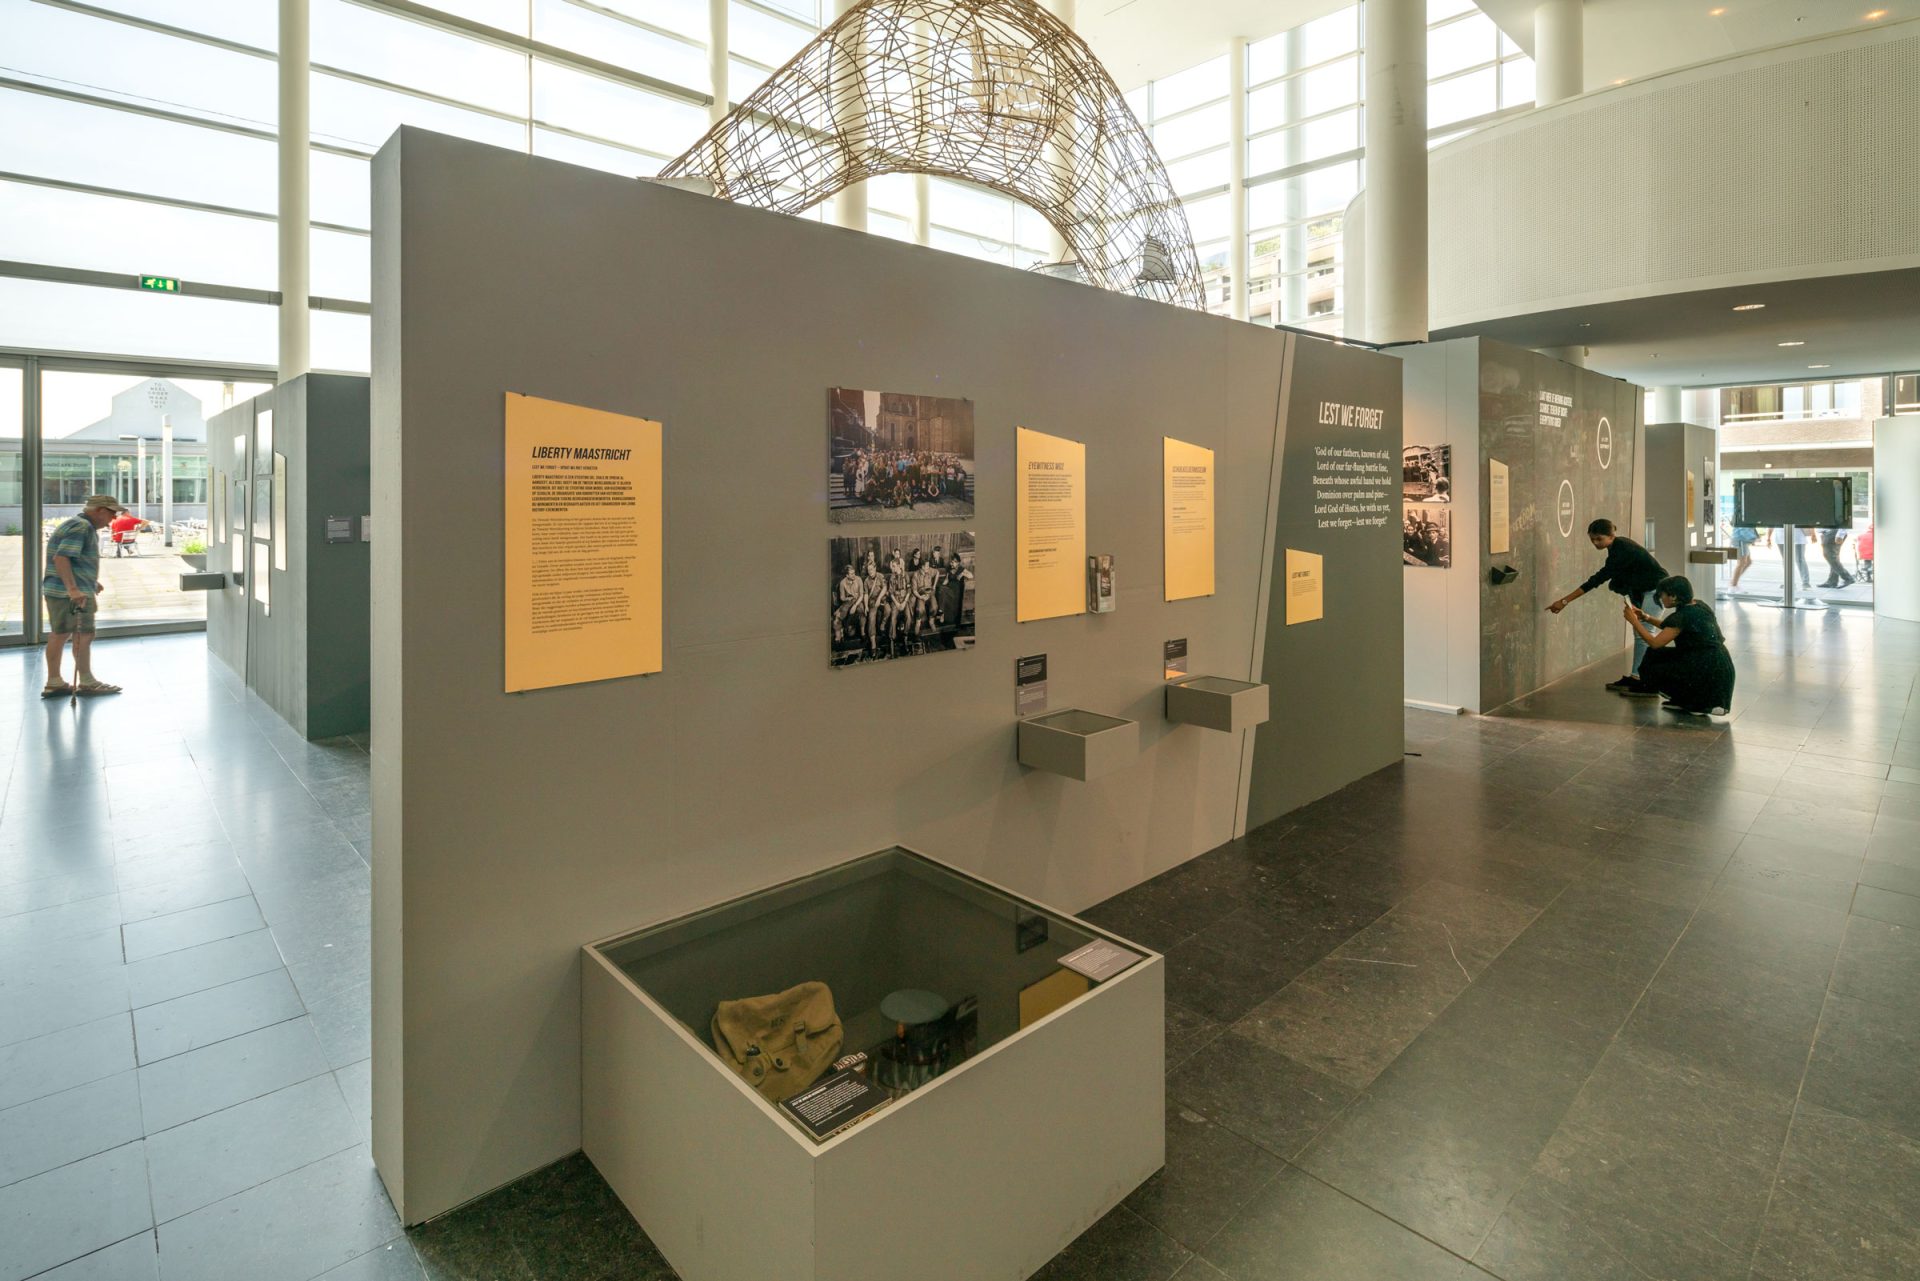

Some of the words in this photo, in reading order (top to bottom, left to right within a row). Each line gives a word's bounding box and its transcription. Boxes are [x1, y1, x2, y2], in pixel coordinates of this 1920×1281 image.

[1319, 402, 1340, 425] LEST
[1341, 404, 1354, 427] WE
[1355, 406, 1383, 430] FORGET
[532, 446, 572, 458] LIBERTY
[574, 448, 631, 460] MAASTRICHT
[1328, 447, 1333, 456] of
[1376, 450, 1382, 459] of
[1317, 461, 1329, 470] Lord
[1330, 462, 1335, 471] of
[1313, 476, 1333, 484] Beneath
[1334, 476, 1349, 485] whose
[1363, 476, 1374, 485] hand
[1382, 476, 1391, 485] hold
[1317, 490, 1341, 499] Dominion
[1353, 490, 1365, 501] palm
[1366, 490, 1374, 498] and
[1314, 504, 1327, 513] Lord
[1328, 504, 1338, 513] God
[1339, 504, 1345, 513] of
[1366, 502, 1376, 512] with
[1318, 519, 1329, 528] Lest
